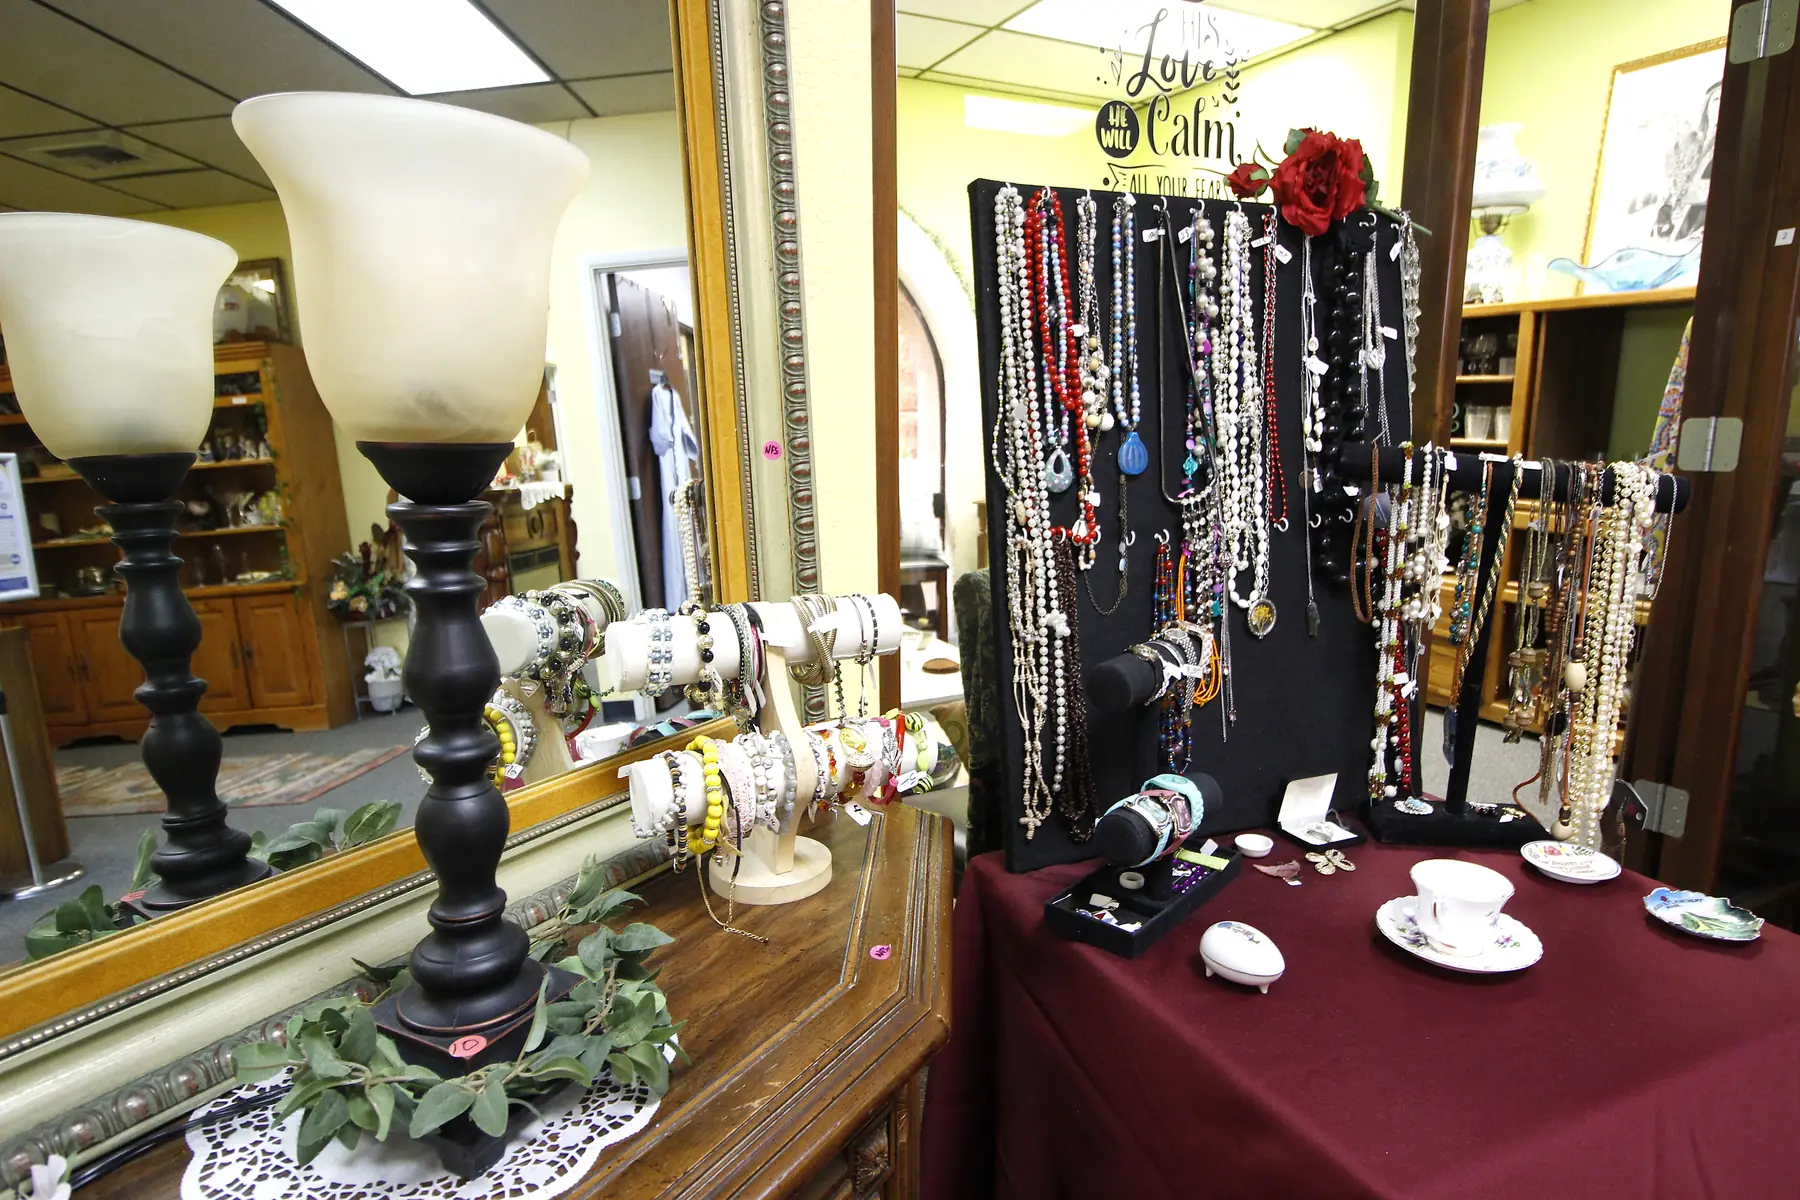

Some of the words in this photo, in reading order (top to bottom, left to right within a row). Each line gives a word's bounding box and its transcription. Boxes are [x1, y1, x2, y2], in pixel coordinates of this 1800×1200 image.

[1126, 7, 1217, 98] Love
[1108, 104, 1128, 128] HE
[1100, 127, 1133, 151] WILL
[1147, 94, 1242, 168] Calm
[1130, 174, 1147, 195] ALL
[1157, 175, 1187, 199] YOUR
[764, 444, 779, 455] NFS
[452, 1038, 480, 1056] 10
